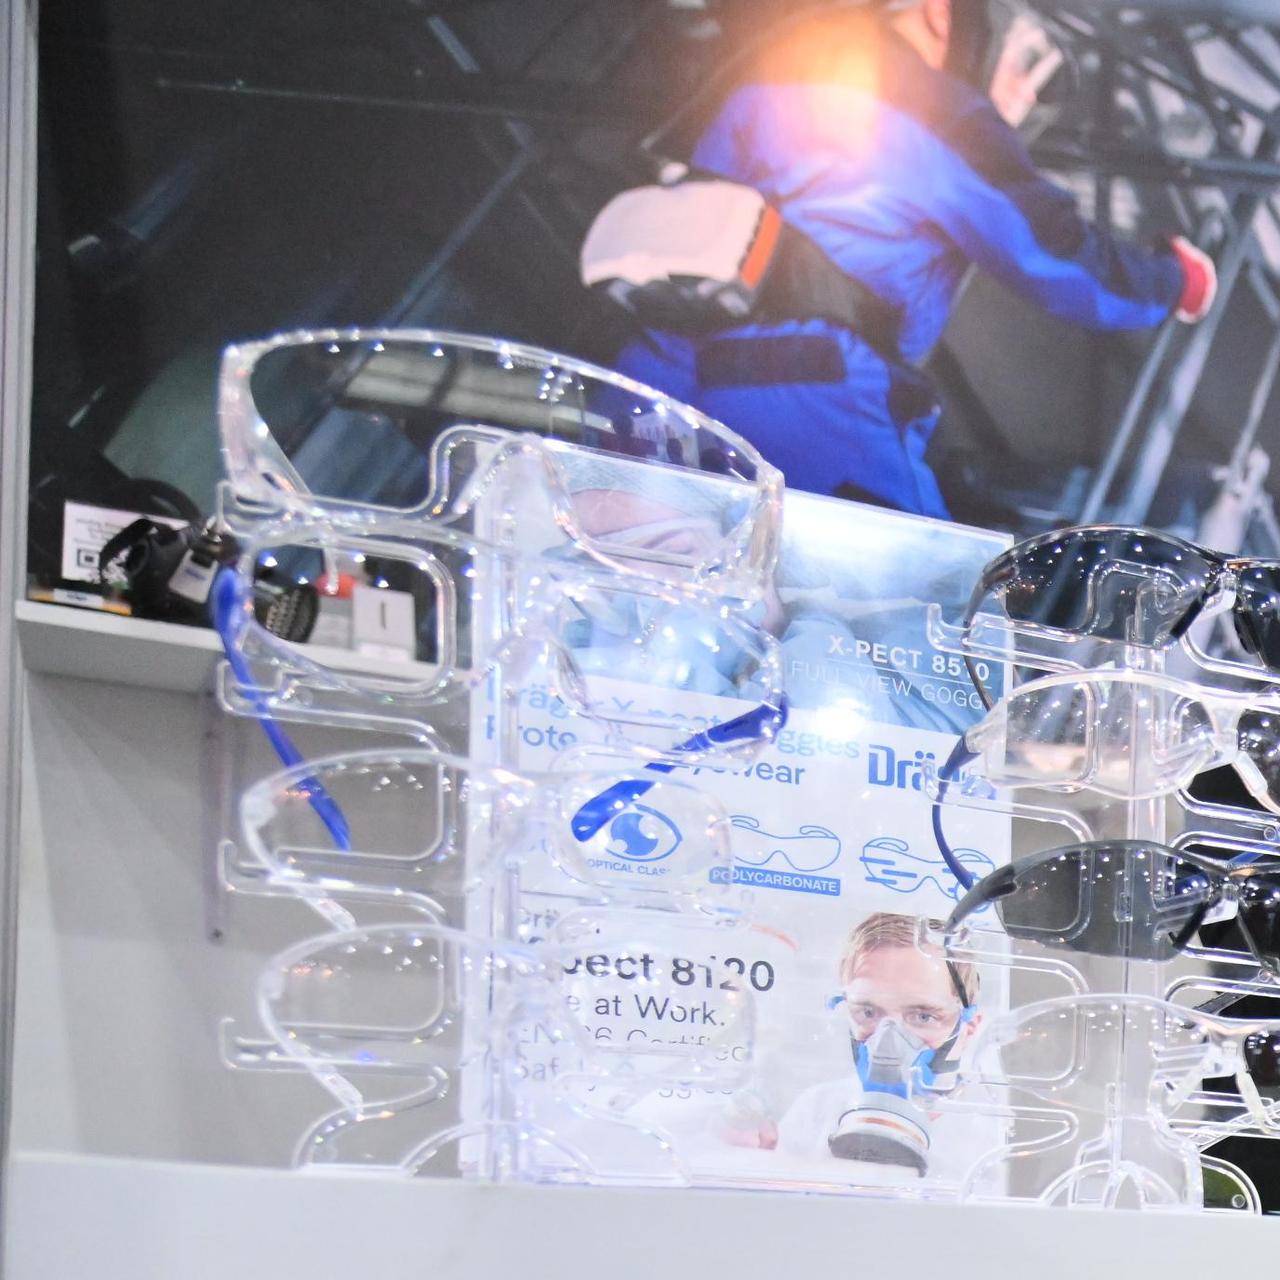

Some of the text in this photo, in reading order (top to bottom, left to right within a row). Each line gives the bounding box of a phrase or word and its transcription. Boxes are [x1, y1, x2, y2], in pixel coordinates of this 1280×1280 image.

[828, 635, 922, 669] X-PECT
[856, 672, 912, 698] VIEW
[594, 993, 726, 1027] at Work.
